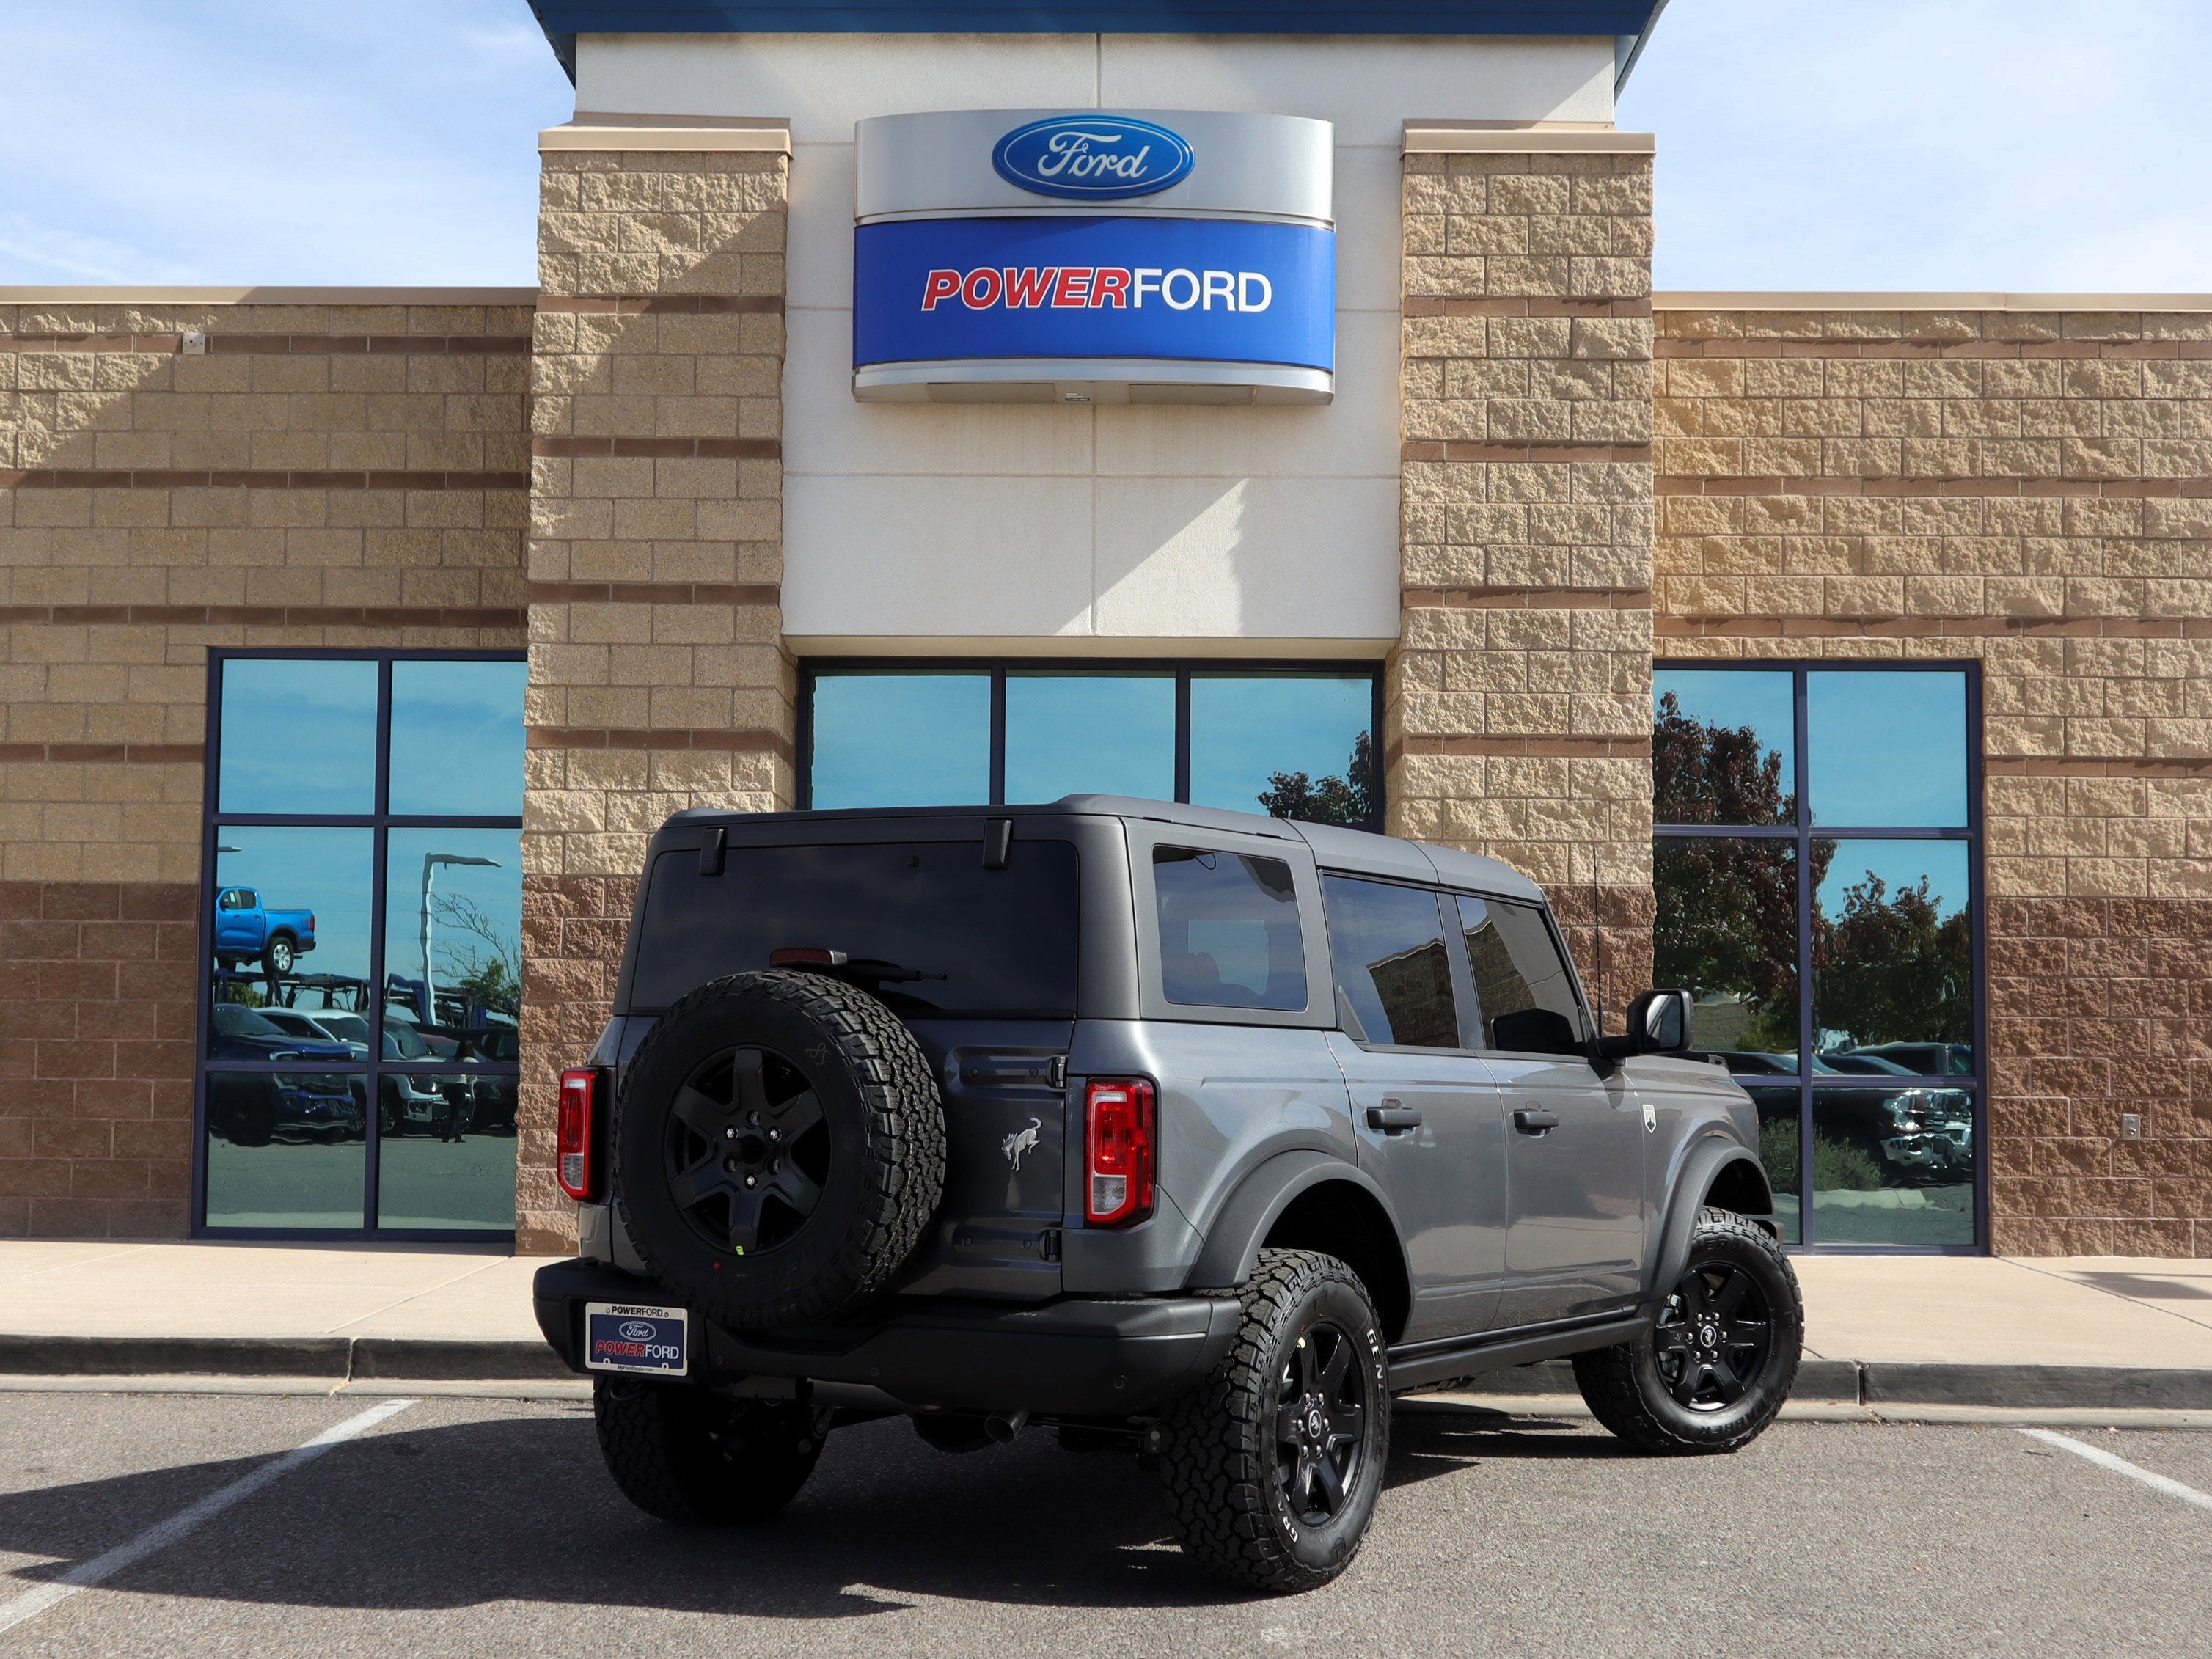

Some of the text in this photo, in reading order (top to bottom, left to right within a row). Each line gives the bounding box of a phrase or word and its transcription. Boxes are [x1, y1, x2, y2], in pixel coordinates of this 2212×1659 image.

[1038, 131, 1150, 178] Ford
[920, 266, 1272, 312] POWERFORD
[626, 1324, 649, 1338] Ford
